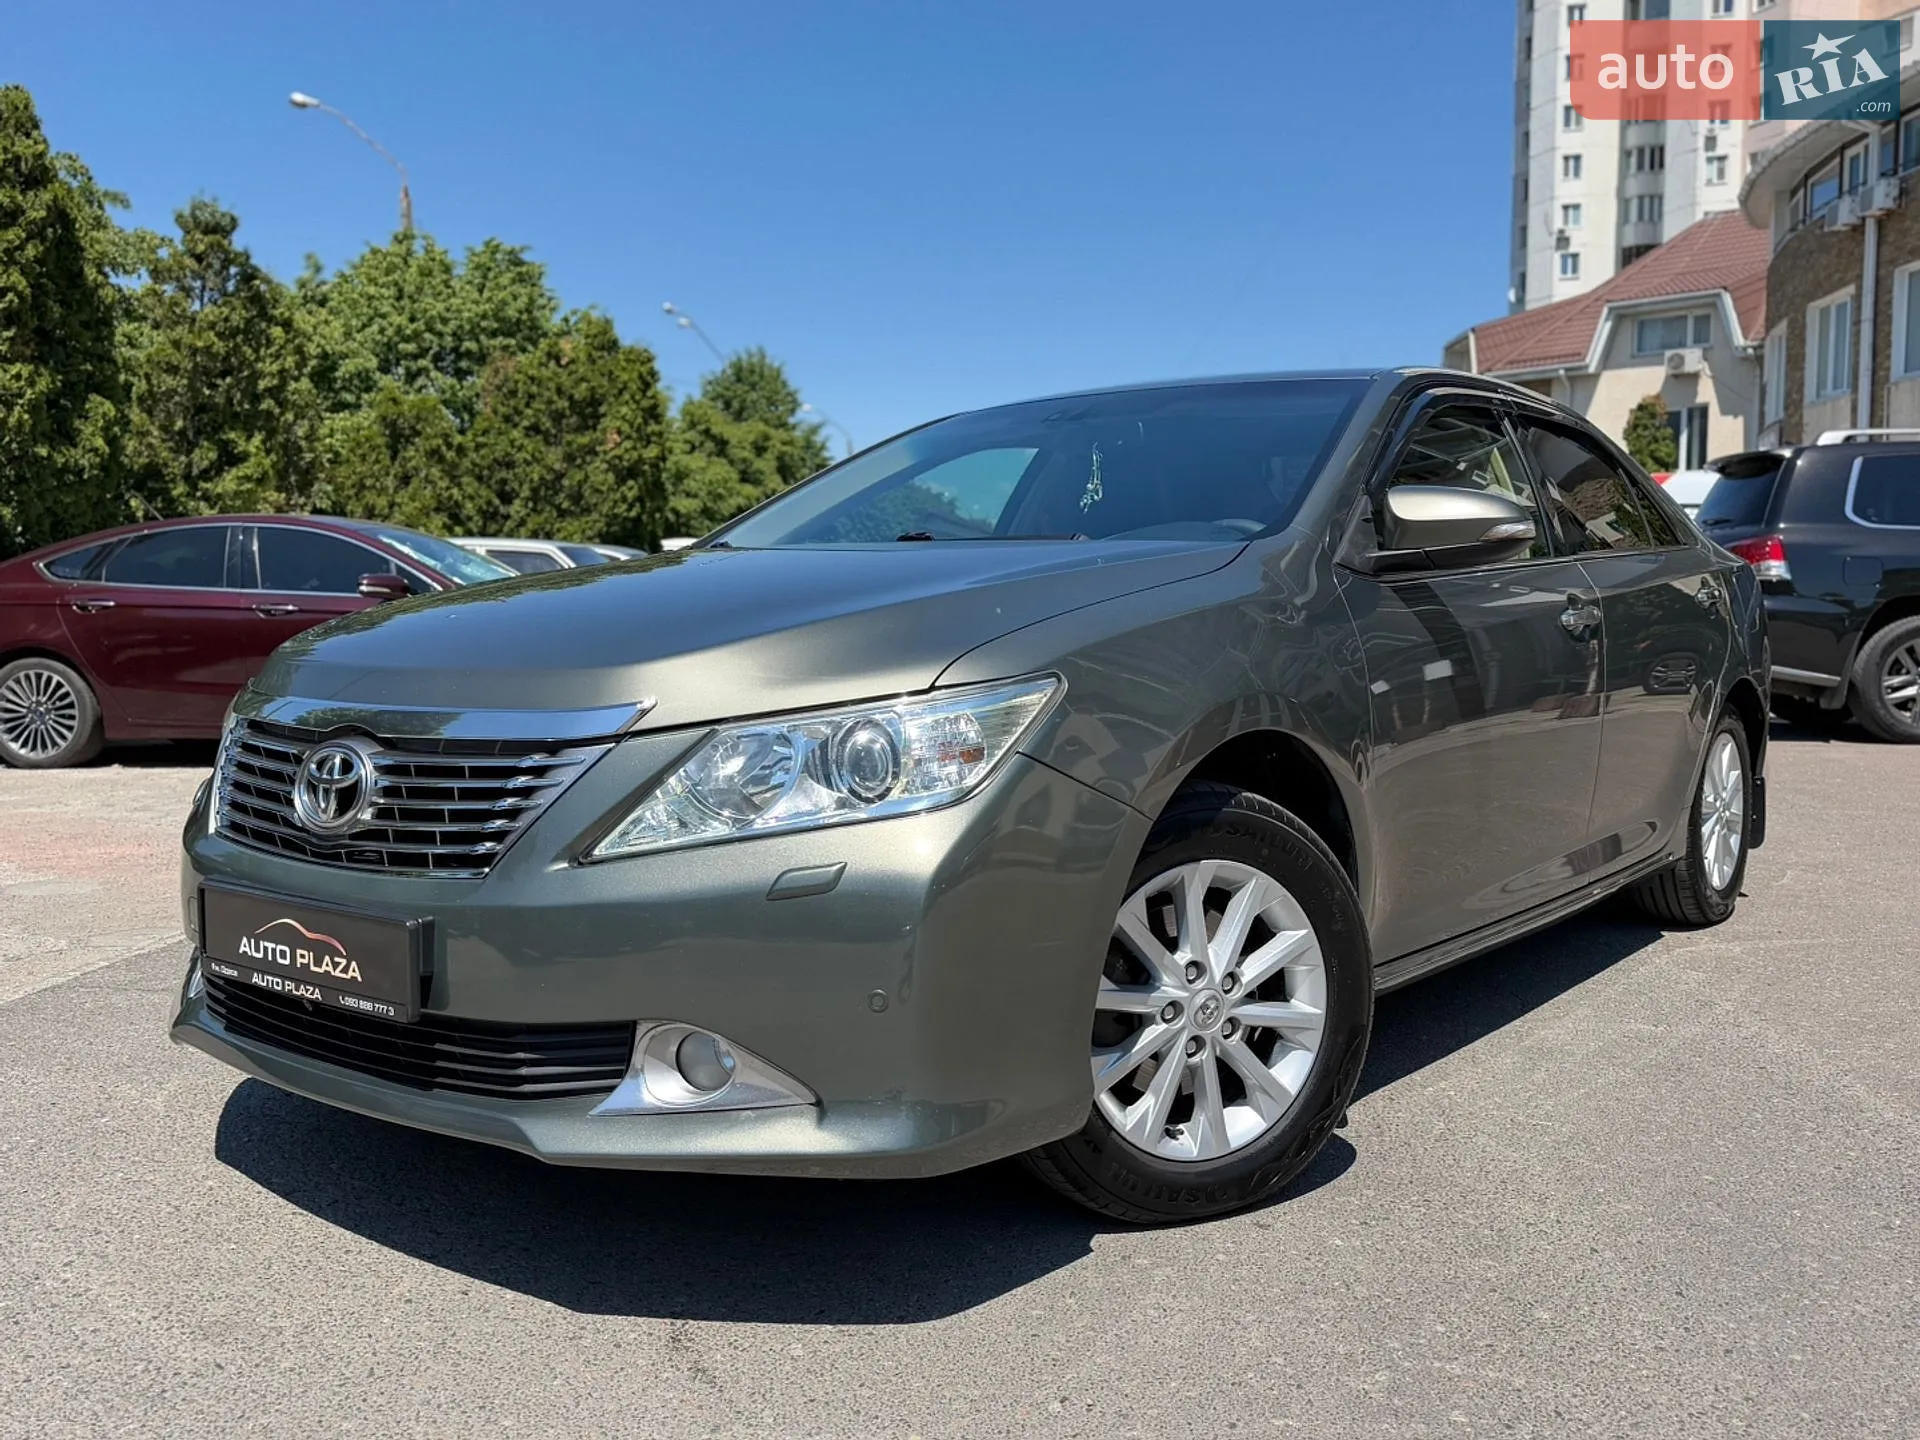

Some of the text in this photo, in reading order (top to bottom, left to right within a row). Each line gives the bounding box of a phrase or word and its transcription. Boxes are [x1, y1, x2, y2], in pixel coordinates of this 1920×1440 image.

[238, 935, 362, 982] AUTO PLAZA
[251, 971, 322, 1001] AUTO PLAZA
